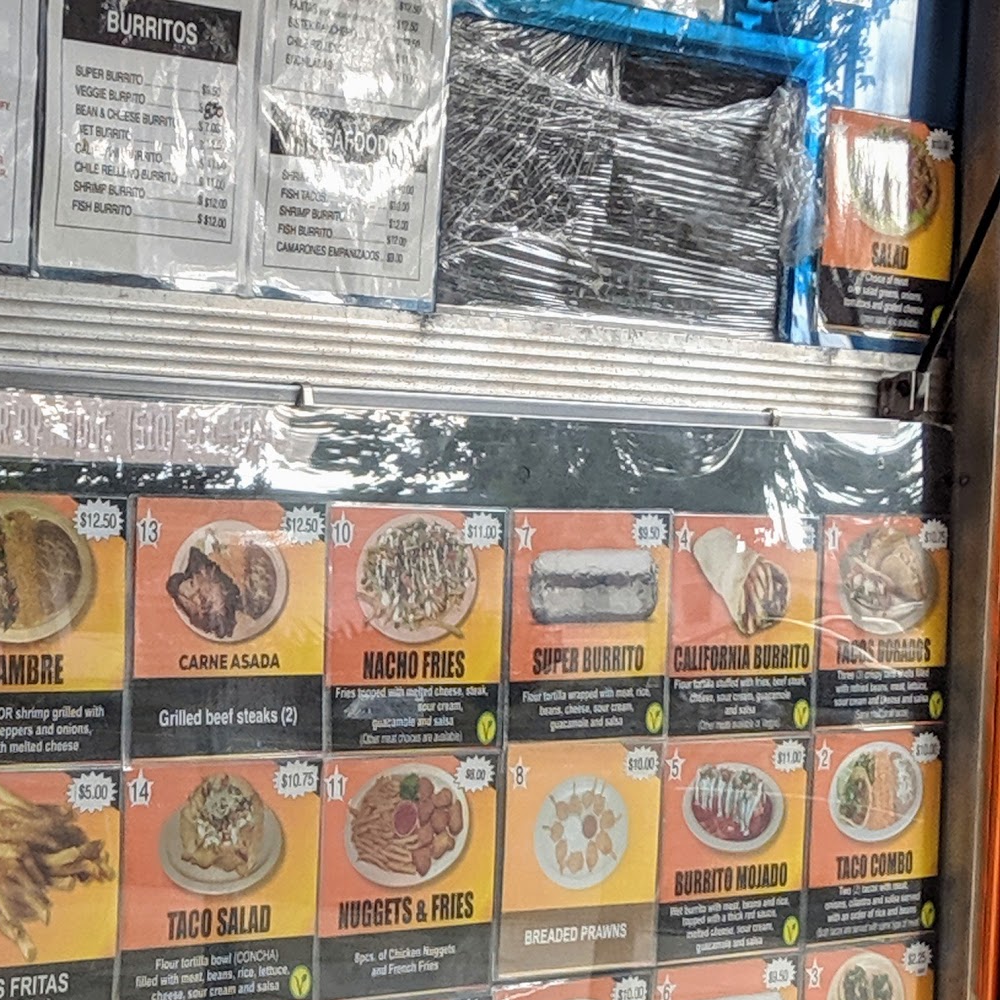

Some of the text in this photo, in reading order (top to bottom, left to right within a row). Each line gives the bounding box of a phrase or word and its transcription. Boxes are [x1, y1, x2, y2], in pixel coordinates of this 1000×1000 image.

[107, 11, 198, 45] BURRITOS
[76, 65, 143, 85] SUPER BURRITO
[72, 200, 131, 216] FISH BURRITO
[278, 223, 333, 239] FISH BURRITO
[276, 242, 326, 257] CAMARONES
[872, 241, 909, 270] SALAD
[80, 511, 117, 529] $12.50
[286, 517, 318, 533] $12.50
[140, 522, 158, 543] 13
[333, 523, 350, 544] 10
[467, 524, 497, 539] $11.00
[523, 527, 530, 546] 7
[681, 532, 688, 546] 4
[179, 653, 280, 671] CARNE ASADA
[363, 650, 466, 679] NACHO FRIES
[533, 645, 644, 675] SUPER BURRITO
[674, 643, 810, 672] CALIFORNIA BURRITO
[159, 707, 297, 727] Grilled beef steaks (2)
[821, 749, 828, 767] 2
[516, 765, 523, 785] 8
[671, 762, 679, 778] 5
[281, 772, 314, 789] $10.75
[329, 779, 345, 797] 11
[78, 785, 108, 800] $5.00
[131, 783, 149, 802] 14
[836, 850, 912, 880] TACO COMBO
[674, 863, 788, 897] BURRITO MOJADO
[338, 891, 474, 929] NUGGETS & FRIES
[167, 905, 271, 941] TACO SALAD
[524, 923, 627, 946] BREADED PRAWNS
[10, 972, 69, 998] FRITAS
[811, 967, 819, 984] 3
[663, 983, 670, 1000] 6
